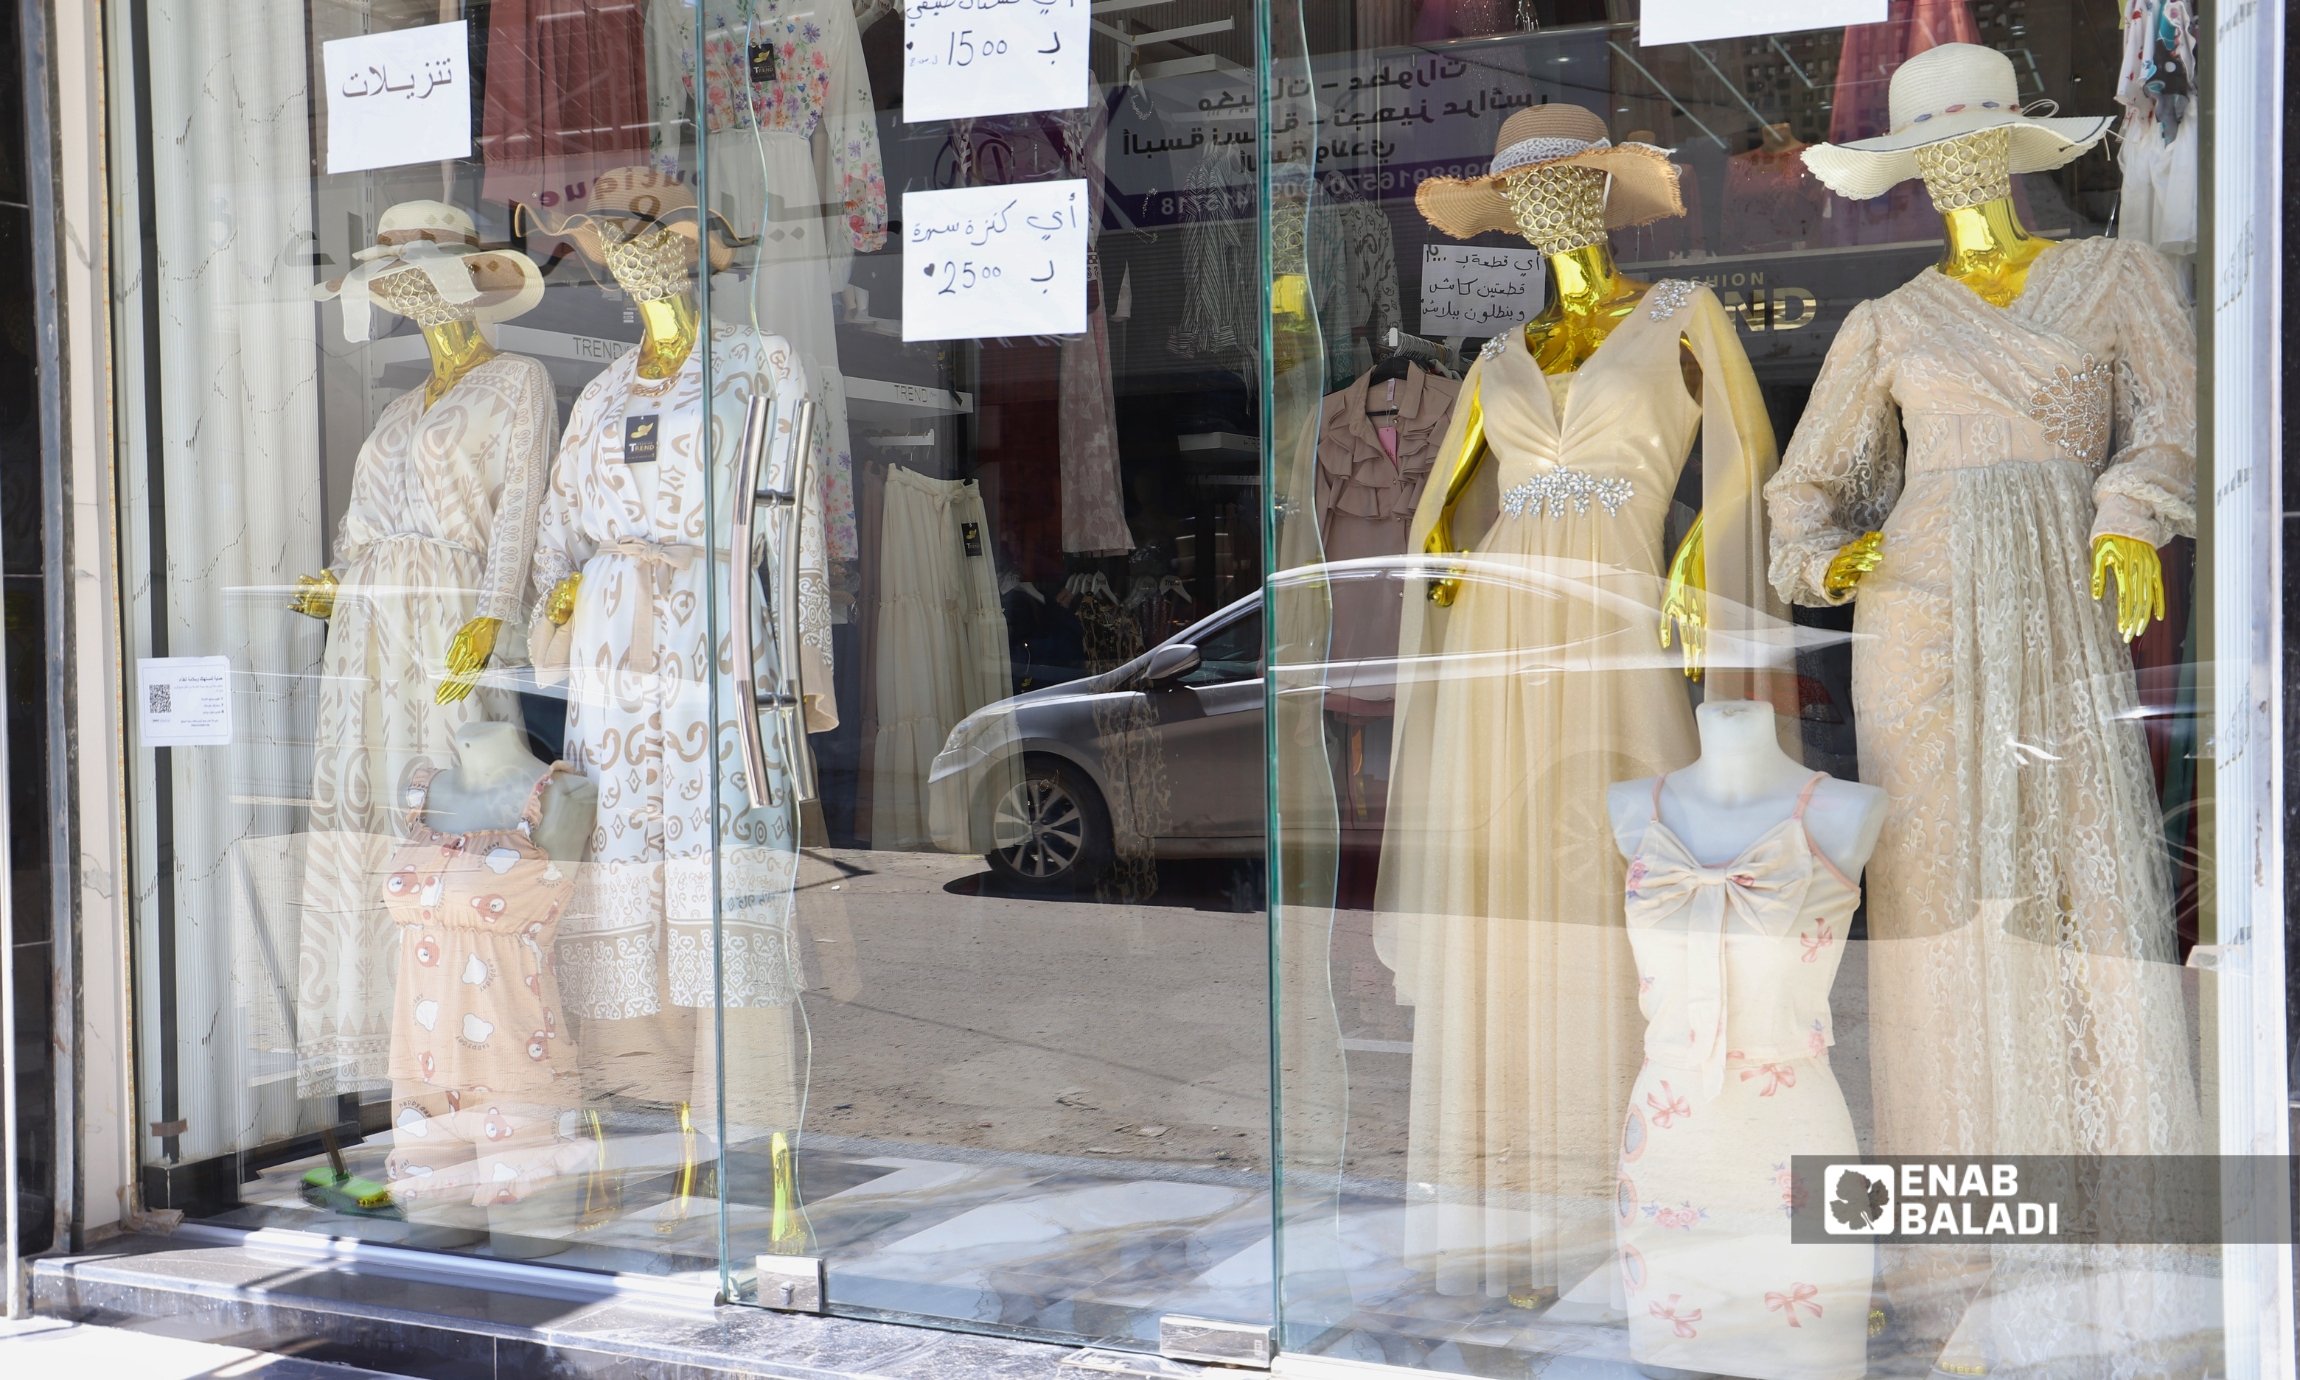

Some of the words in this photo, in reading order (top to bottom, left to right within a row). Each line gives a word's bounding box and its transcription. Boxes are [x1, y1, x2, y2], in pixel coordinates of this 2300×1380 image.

[948, 30, 1007, 66] 1500
[1037, 31, 1061, 65] ب
[342, 57, 452, 99] تنزيلات
[965, 199, 1017, 246] كنزة
[1027, 192, 1076, 241] أي
[938, 261, 1001, 295] 2500
[1030, 260, 1054, 294] ب
[1472, 254, 1508, 269] قطعة
[1514, 251, 1541, 277] أي
[1429, 278, 1478, 295] كاش
[1477, 282, 1525, 297] قطعتين
[573, 337, 623, 360] TREND
[894, 384, 927, 403] TREND
